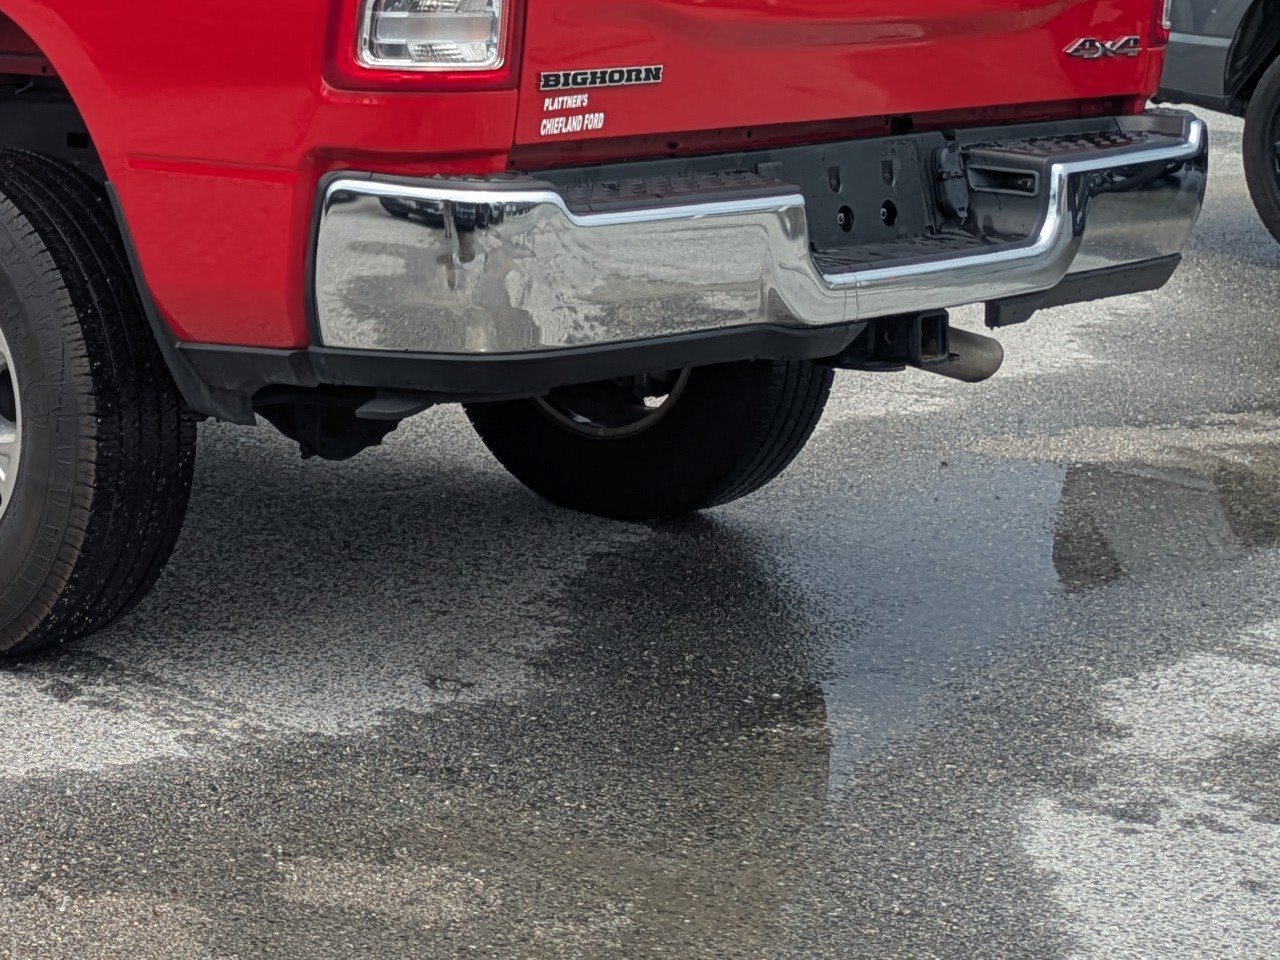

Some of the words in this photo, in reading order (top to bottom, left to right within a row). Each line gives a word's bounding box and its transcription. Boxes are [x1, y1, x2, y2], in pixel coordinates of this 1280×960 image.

[540, 65, 664, 90] BIGHORN
[543, 93, 589, 111] PLATTNER'S
[540, 114, 583, 136] CHIEFLAND
[583, 112, 605, 131] FORD
